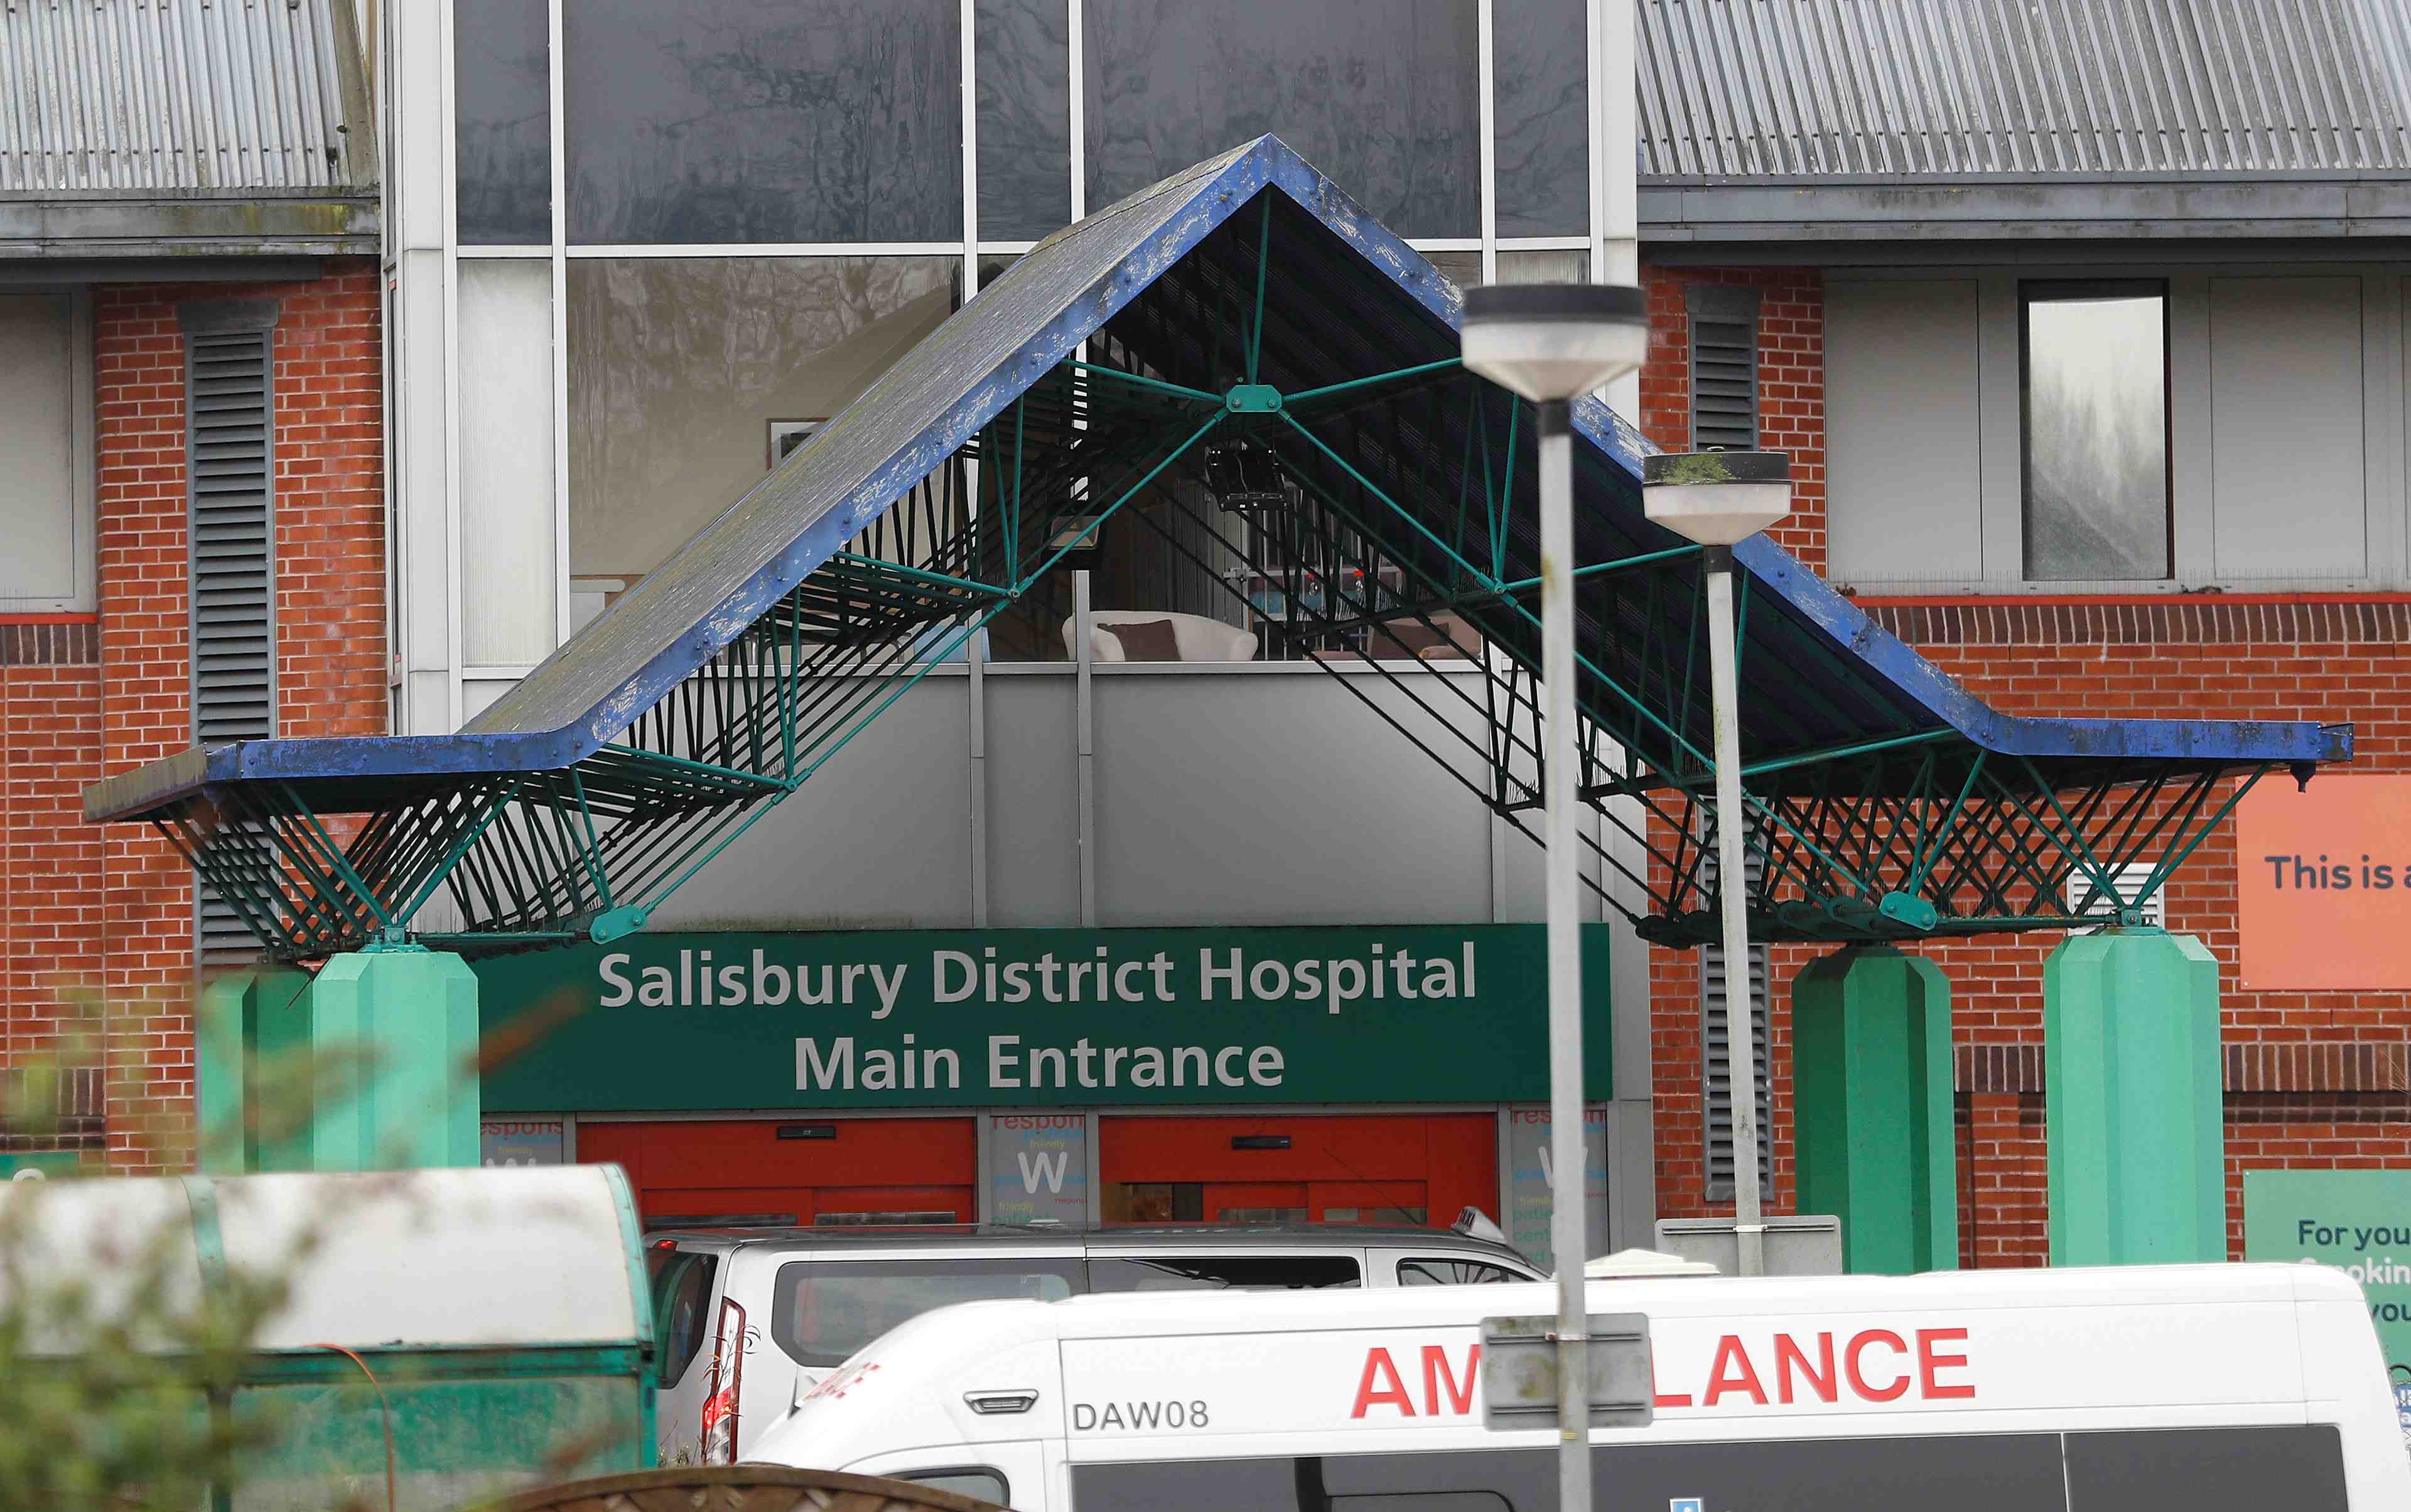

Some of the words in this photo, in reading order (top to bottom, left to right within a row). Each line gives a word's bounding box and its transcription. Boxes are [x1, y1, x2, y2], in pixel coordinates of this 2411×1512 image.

[2264, 854, 2352, 889] This
[2362, 854, 2394, 889] is
[598, 948, 908, 1019] Salisbury
[933, 946, 1175, 1003] District
[1199, 941, 1476, 1014] Hospital
[795, 1034, 960, 1091] Main
[988, 1035, 1286, 1088] Entrance
[1017, 1151, 1068, 1195] W
[2297, 1219, 2348, 1246] For
[2353, 1226, 2411, 1251] you
[2300, 1256, 2411, 1285] okin
[1350, 1327, 1975, 1419] AMLANCE
[1072, 1400, 1210, 1432] DAW08
